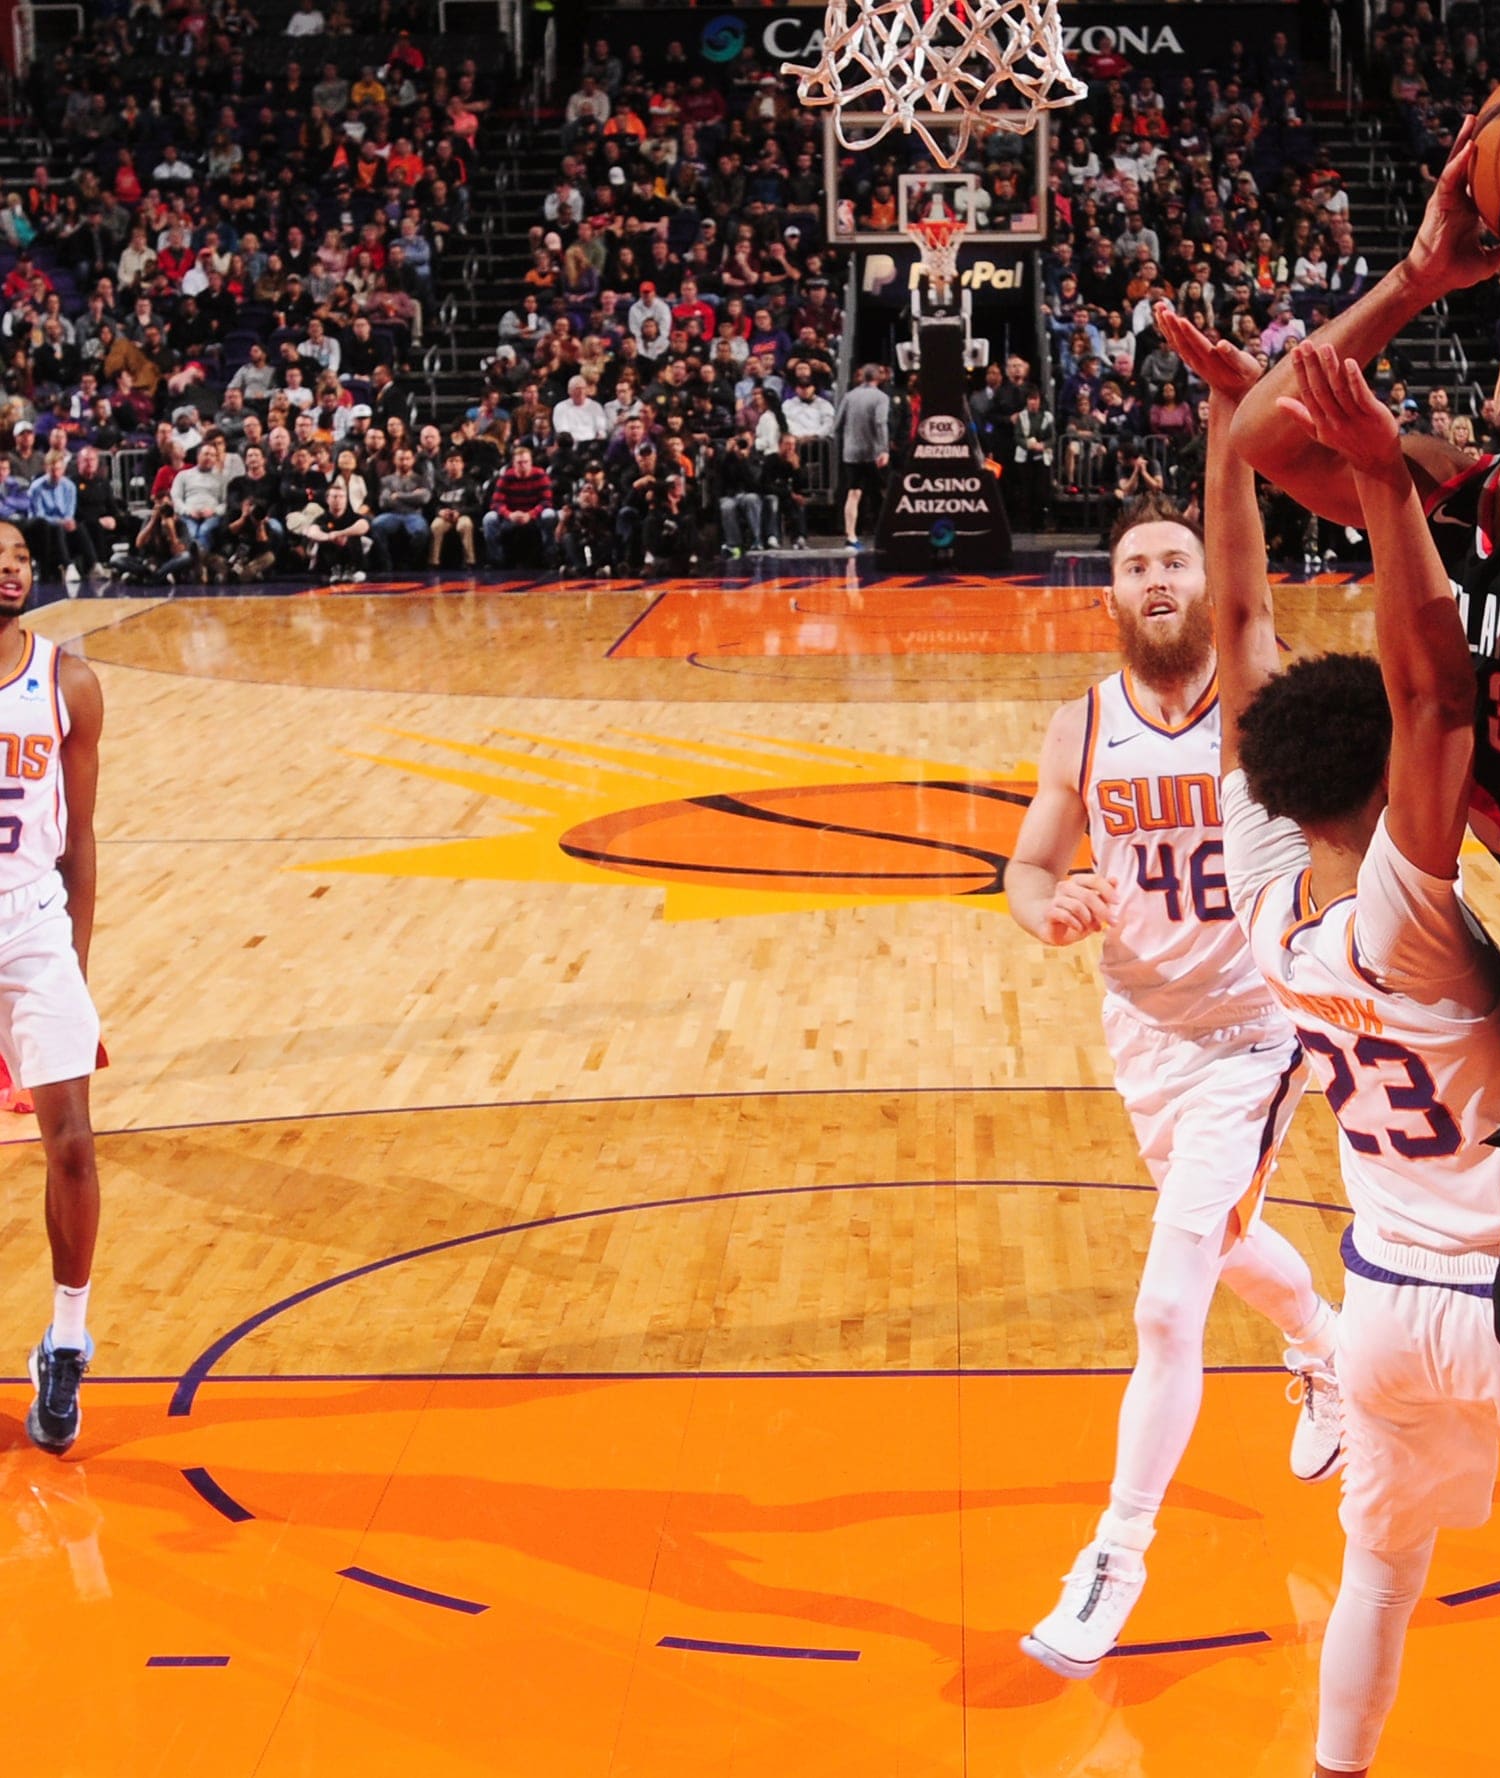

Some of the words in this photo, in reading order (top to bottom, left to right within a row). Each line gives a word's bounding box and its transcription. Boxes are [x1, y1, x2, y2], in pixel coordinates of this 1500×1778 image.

[1061, 25, 1184, 54] ZONA
[929, 421, 953, 432] FOX
[914, 444, 970, 458] ARIZONA
[903, 472, 981, 493] CASINO
[895, 494, 989, 513] ARIZONA
[1097, 772, 1223, 837] SUN
[1132, 840, 1236, 921] 46
[1296, 1026, 1466, 1158] 23
